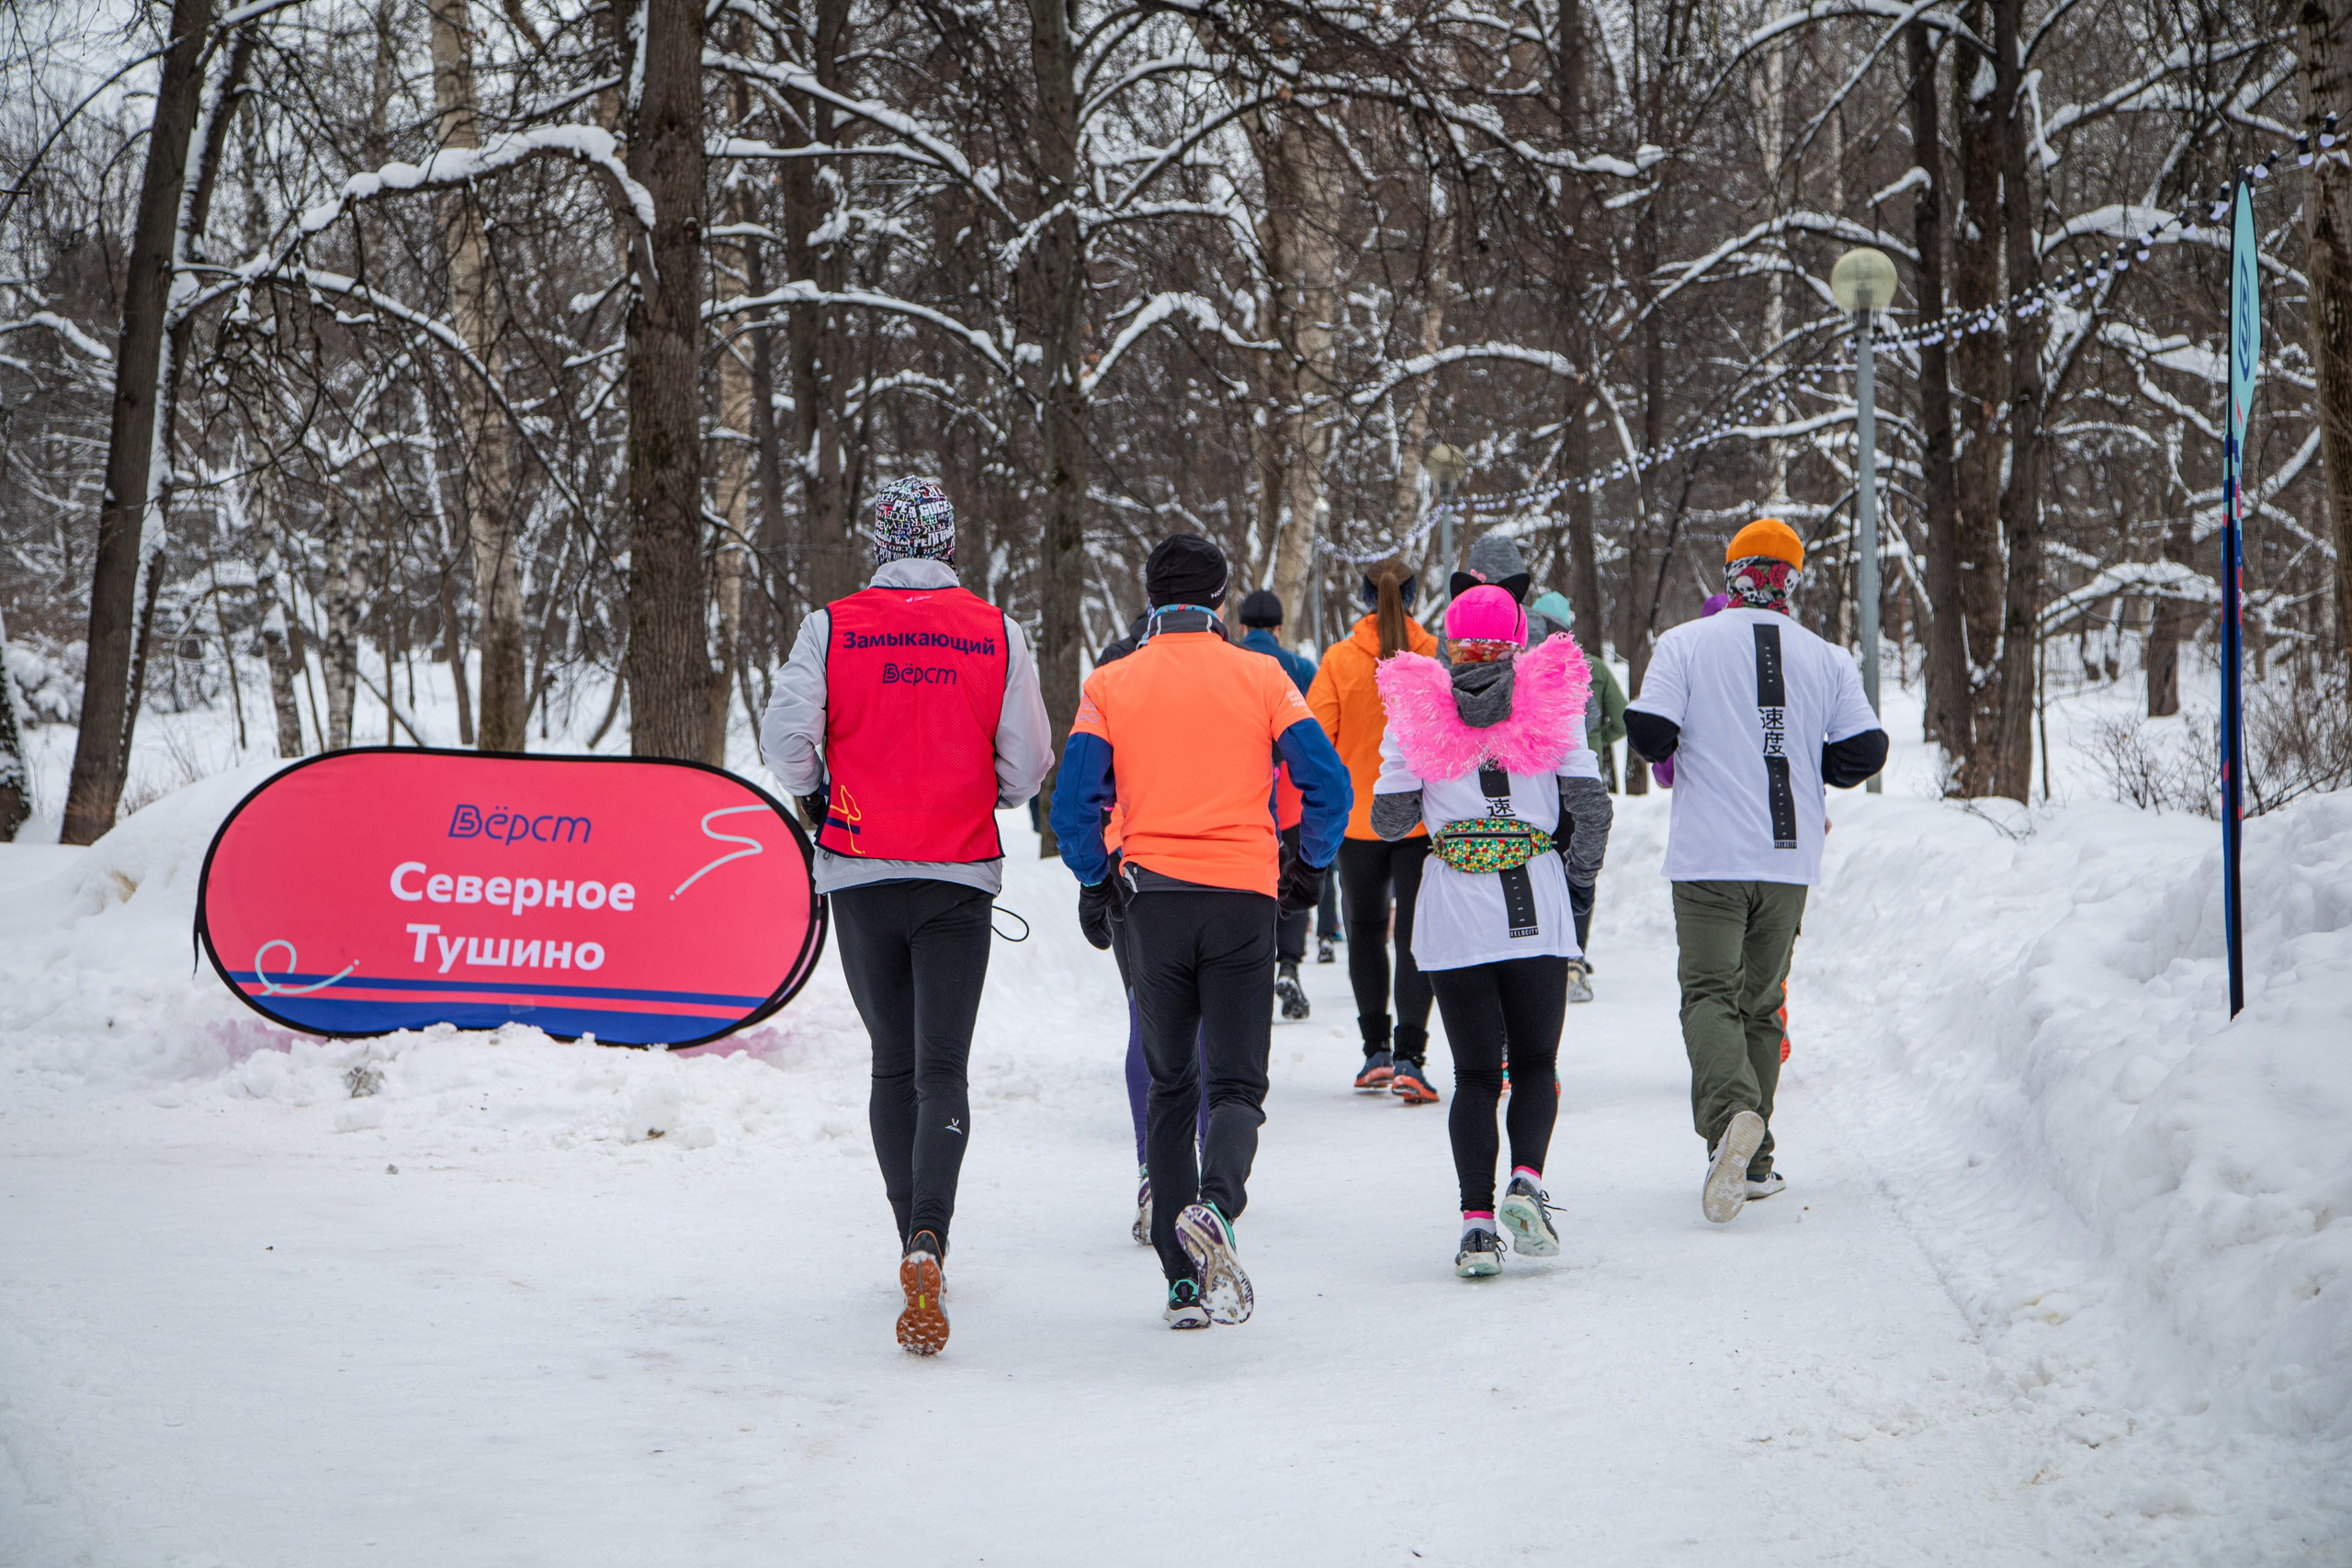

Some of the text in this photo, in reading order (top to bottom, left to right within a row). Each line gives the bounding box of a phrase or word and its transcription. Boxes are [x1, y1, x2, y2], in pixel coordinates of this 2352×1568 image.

[842, 631, 995, 656] Замыкающий
[1758, 707, 1785, 756] 速度
[390, 862, 635, 916] Северное
[406, 923, 605, 974] Тушино
[1510, 928, 1539, 938] VELOCITY
